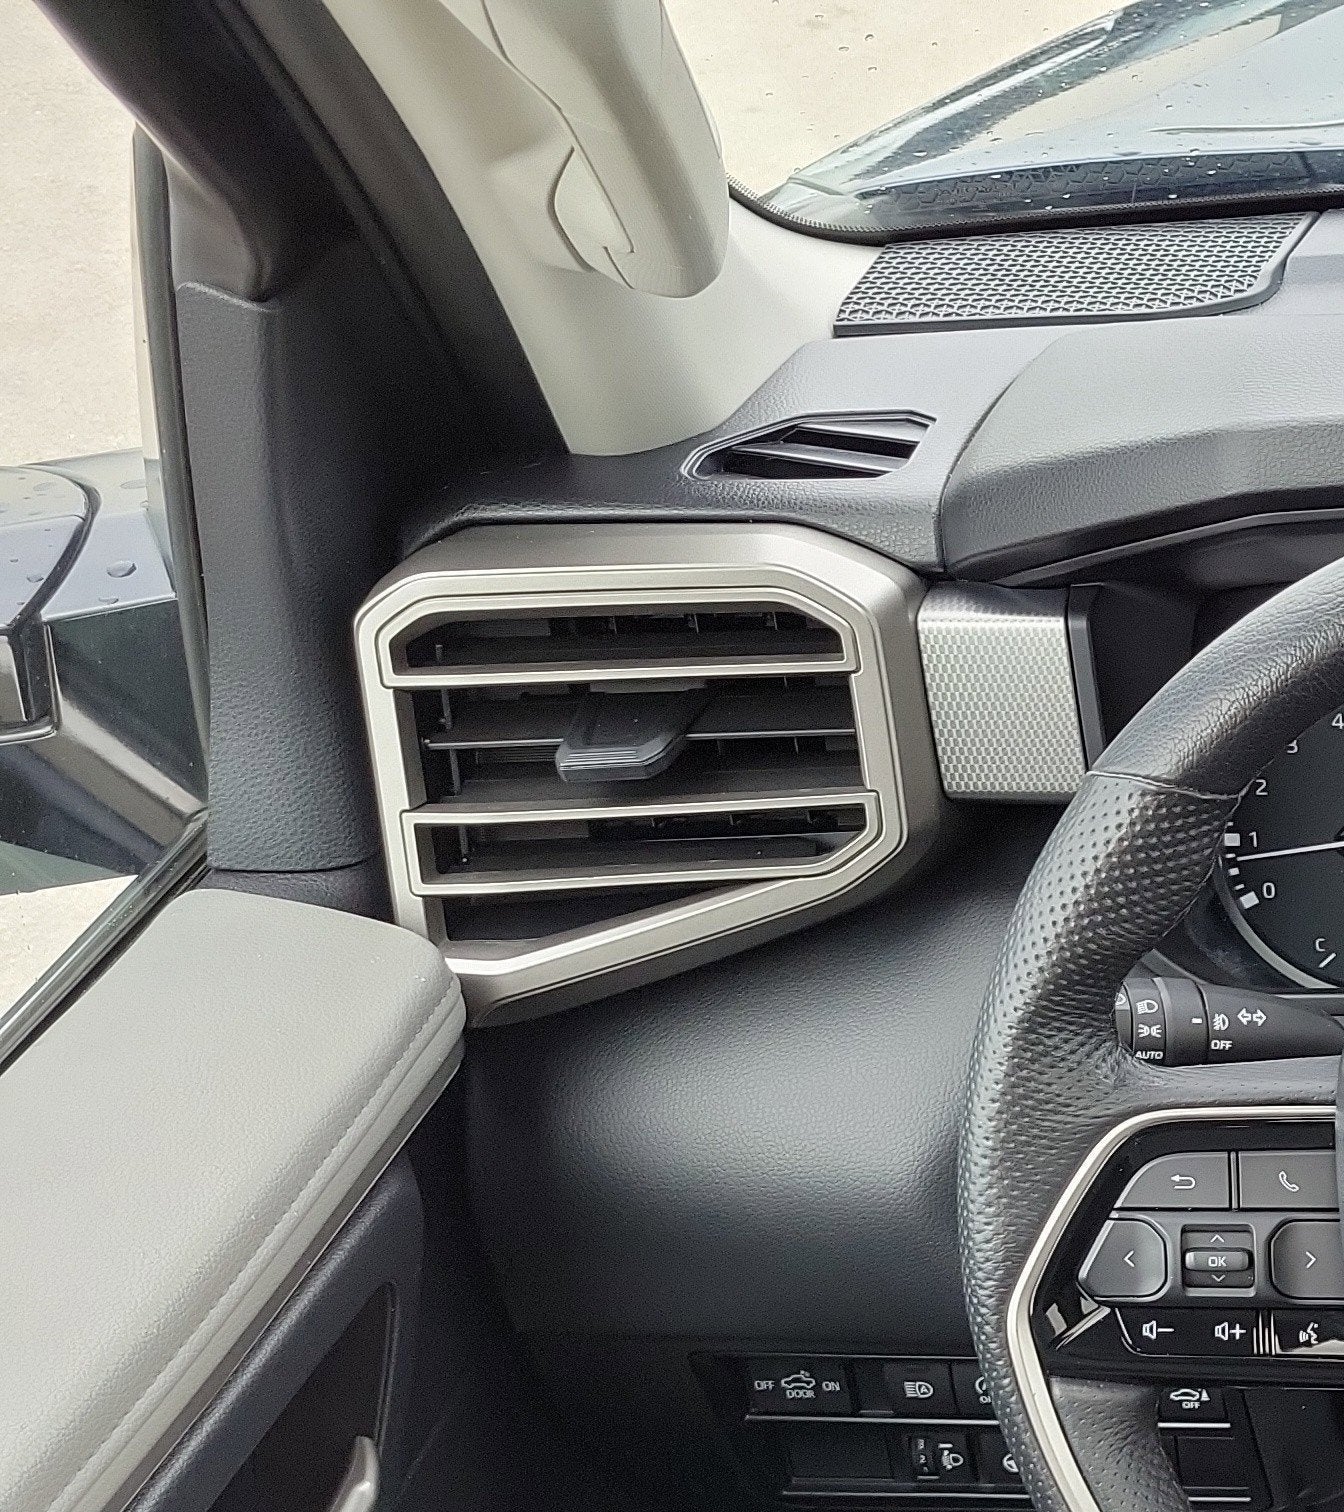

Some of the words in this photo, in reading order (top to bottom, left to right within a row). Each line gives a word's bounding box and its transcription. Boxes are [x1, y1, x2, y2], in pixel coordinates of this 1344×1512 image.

[1255, 779, 1269, 796] 2
[1248, 831, 1259, 847] 1
[1262, 882, 1277, 899] 0
[1315, 937, 1326, 952] C
[1210, 1039, 1234, 1051] OFF
[1135, 1049, 1164, 1061] AUTO
[1207, 1255, 1227, 1269] OK
[754, 1380, 775, 1391] OFF
[822, 1381, 841, 1391] ON
[786, 1389, 817, 1399] DOOR
[1181, 1400, 1201, 1410] OFF
